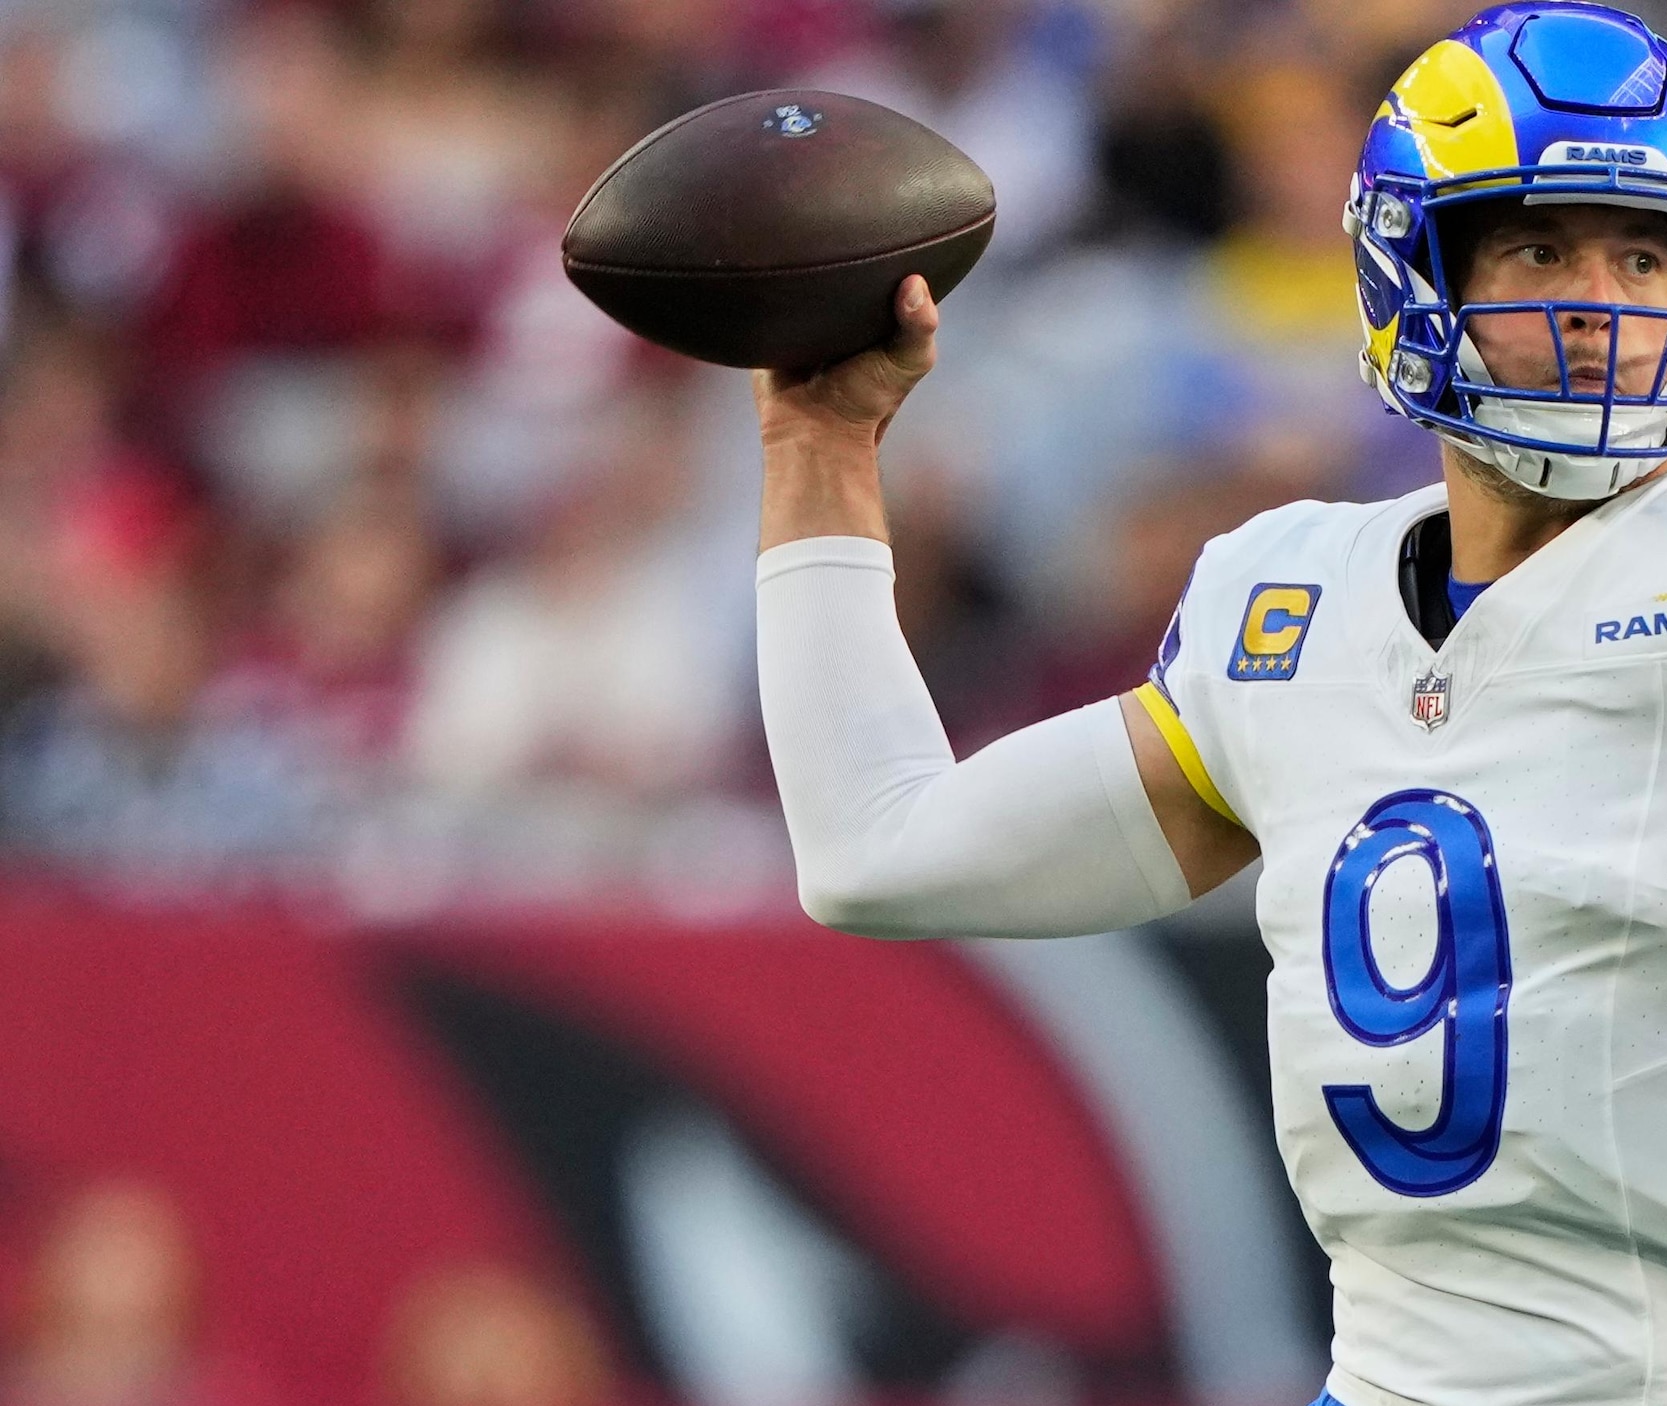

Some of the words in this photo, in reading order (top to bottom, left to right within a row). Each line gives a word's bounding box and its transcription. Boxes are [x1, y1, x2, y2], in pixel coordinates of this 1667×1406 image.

[1566, 146, 1647, 165] RAMS
[1243, 588, 1311, 655] C
[1416, 696, 1443, 720] NFL
[1322, 788, 1512, 1198] 9
